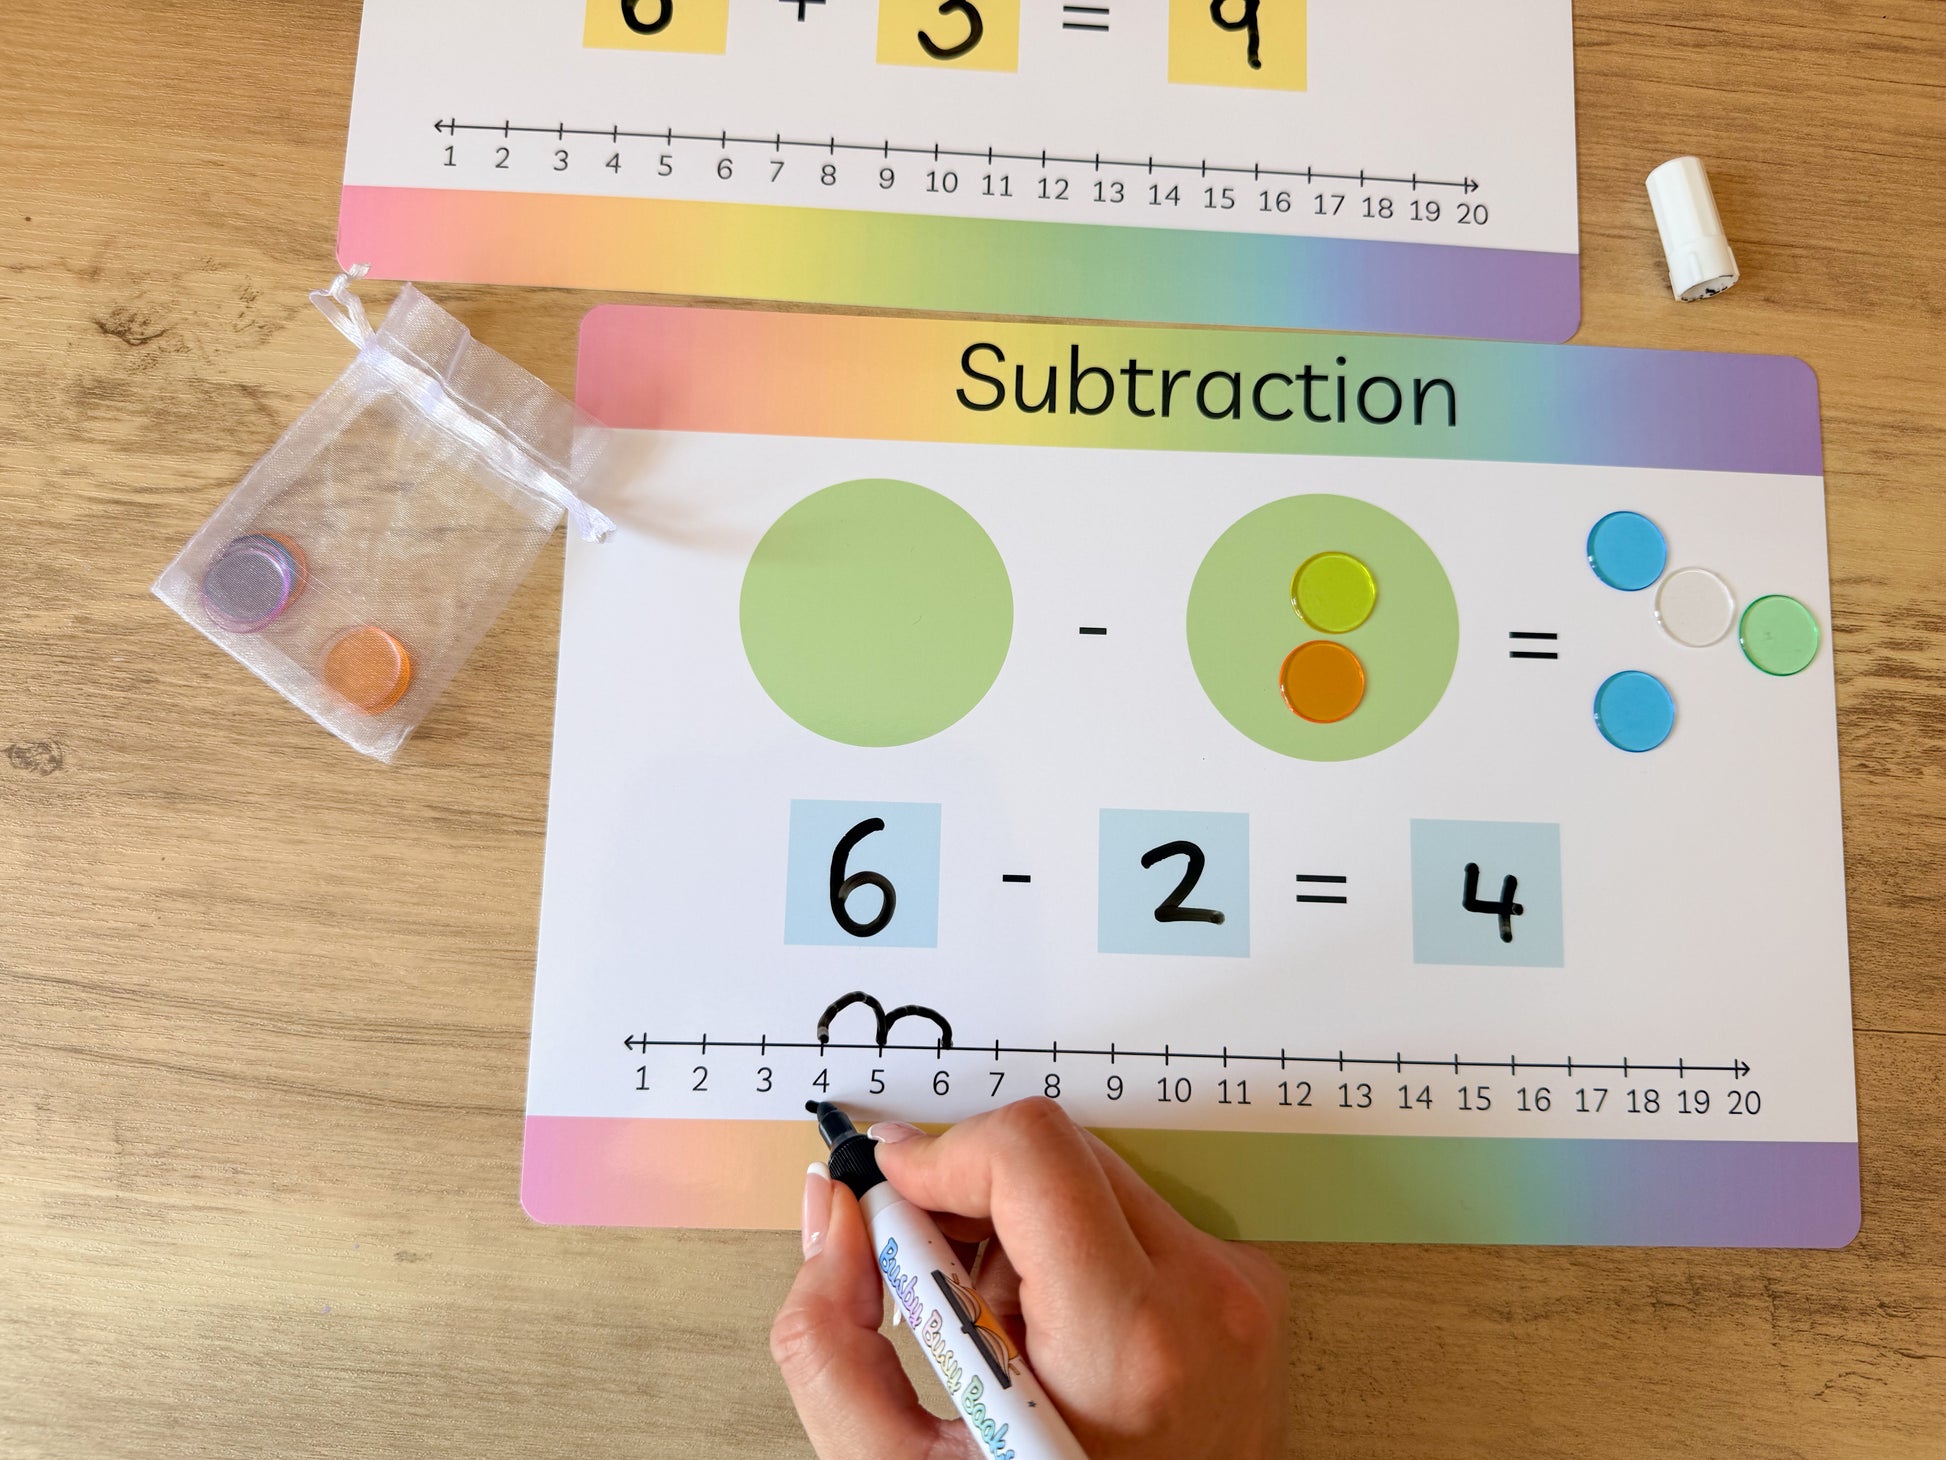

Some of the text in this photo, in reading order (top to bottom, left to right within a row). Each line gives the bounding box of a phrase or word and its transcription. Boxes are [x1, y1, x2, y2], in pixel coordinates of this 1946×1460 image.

[917, 0, 984, 60] 3
[1209, 0, 1262, 70] 9
[443, 145, 1489, 226] 1 2 3 4 5 6 7 8 9 10 11 12 13 14 15 16 17 18 19 20
[956, 342, 1457, 427] Subtraction
[829, 817, 897, 938] 6
[1140, 840, 1226, 925] 2
[1462, 862, 1525, 944] 4
[635, 1065, 1761, 1115] 1 2 3 4 5 6 7 8 9 10 11 12 13 14 15 16 17 18 19 20
[879, 1237, 923, 1330] Busby
[922, 1309, 962, 1395] Busy
